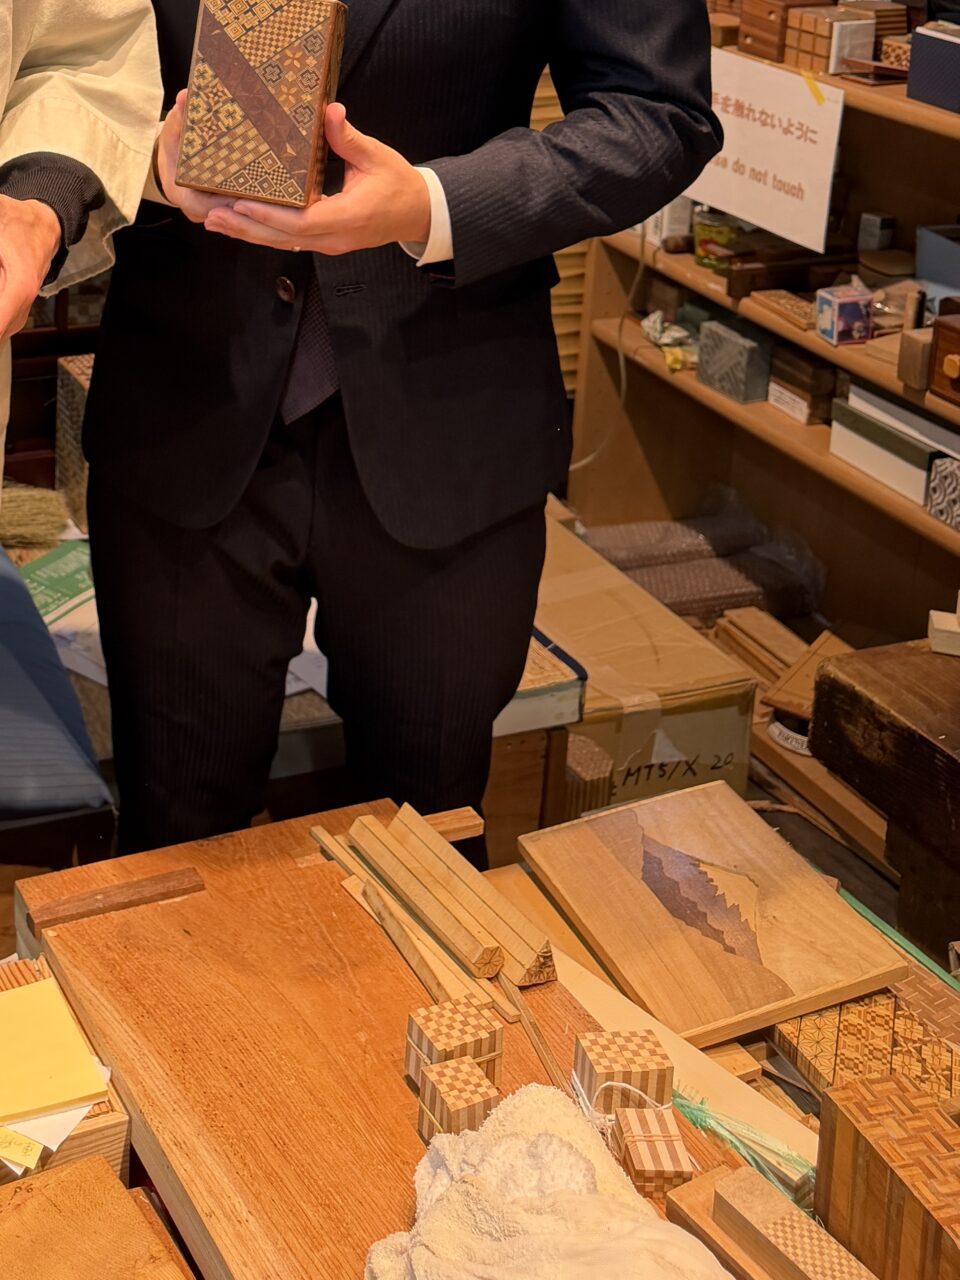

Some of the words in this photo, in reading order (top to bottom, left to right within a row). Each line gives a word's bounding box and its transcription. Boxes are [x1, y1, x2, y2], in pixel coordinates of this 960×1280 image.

[732, 157, 746, 176] do
[749, 167, 768, 186] not
[772, 173, 805, 201] touch
